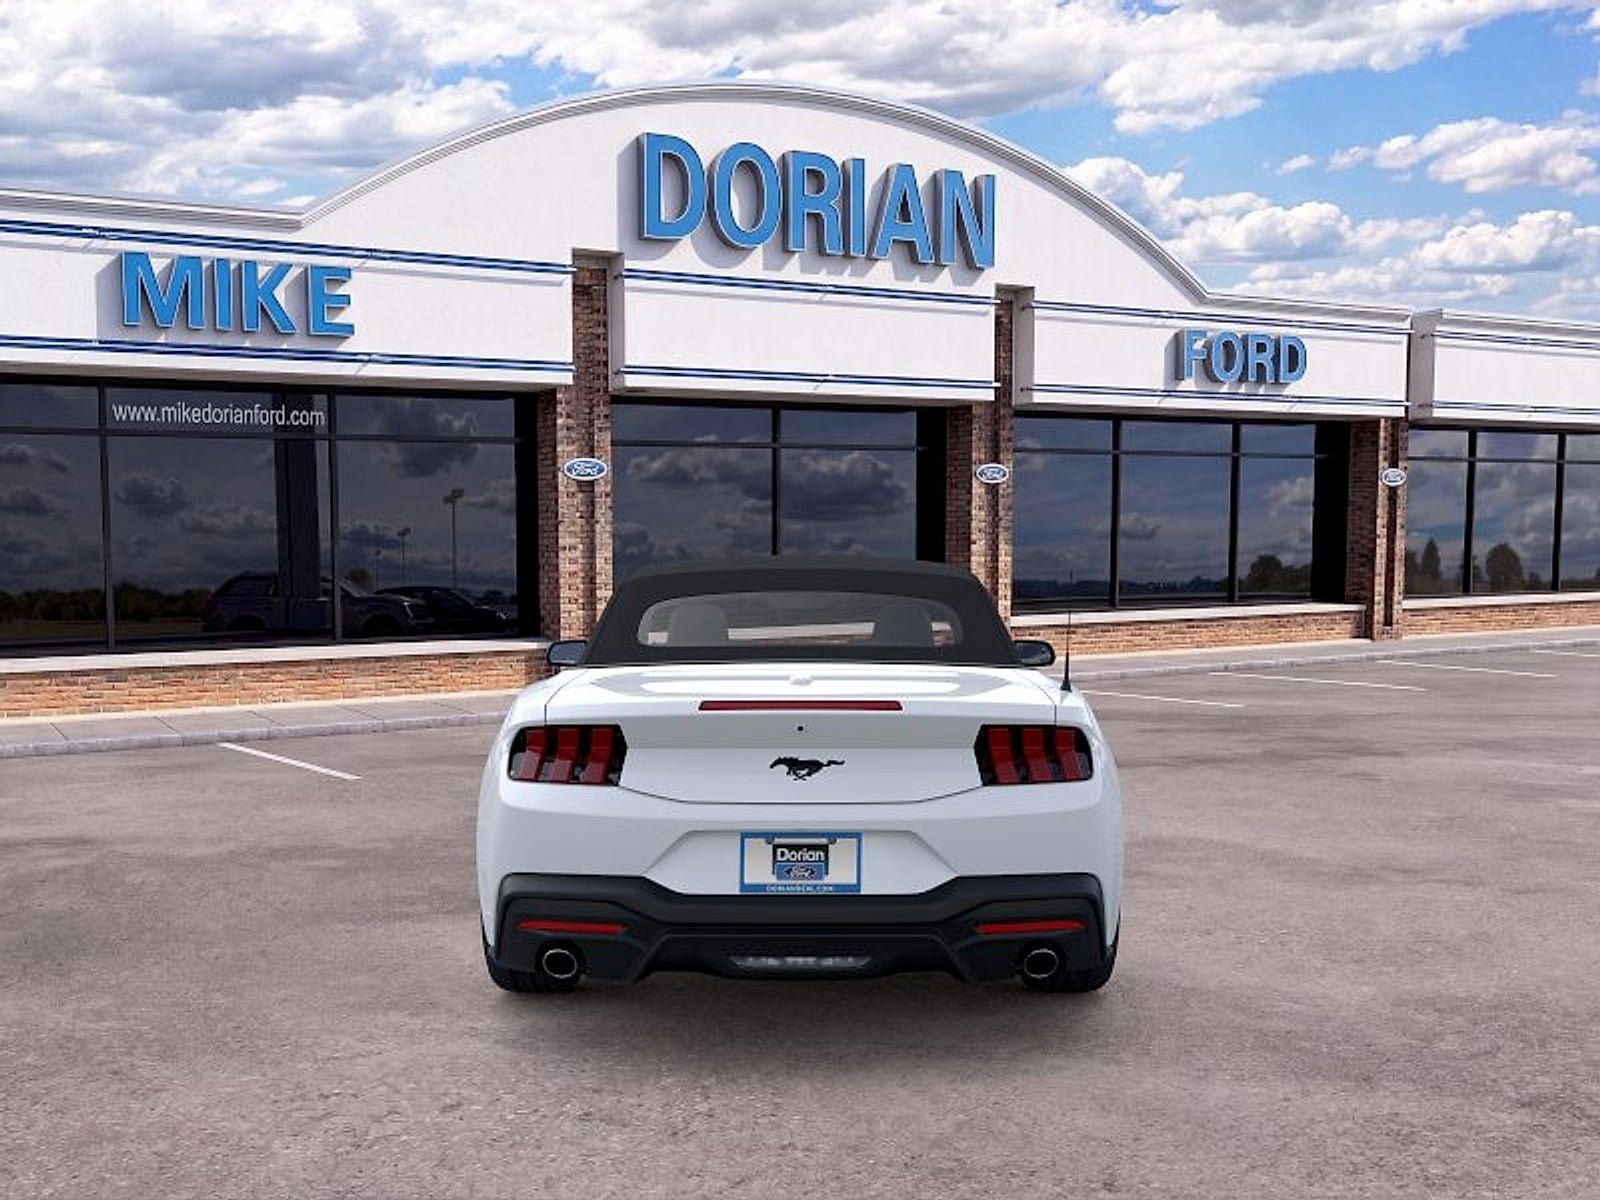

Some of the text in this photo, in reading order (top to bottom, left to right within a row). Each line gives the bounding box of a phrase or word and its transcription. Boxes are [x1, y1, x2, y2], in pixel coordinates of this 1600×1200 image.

[640, 131, 996, 271] DORIAN
[121, 250, 355, 338] MIKE
[1178, 328, 1308, 384] FORD
[111, 402, 326, 427] www.mikedorianford.com
[776, 847, 826, 862] Dorian
